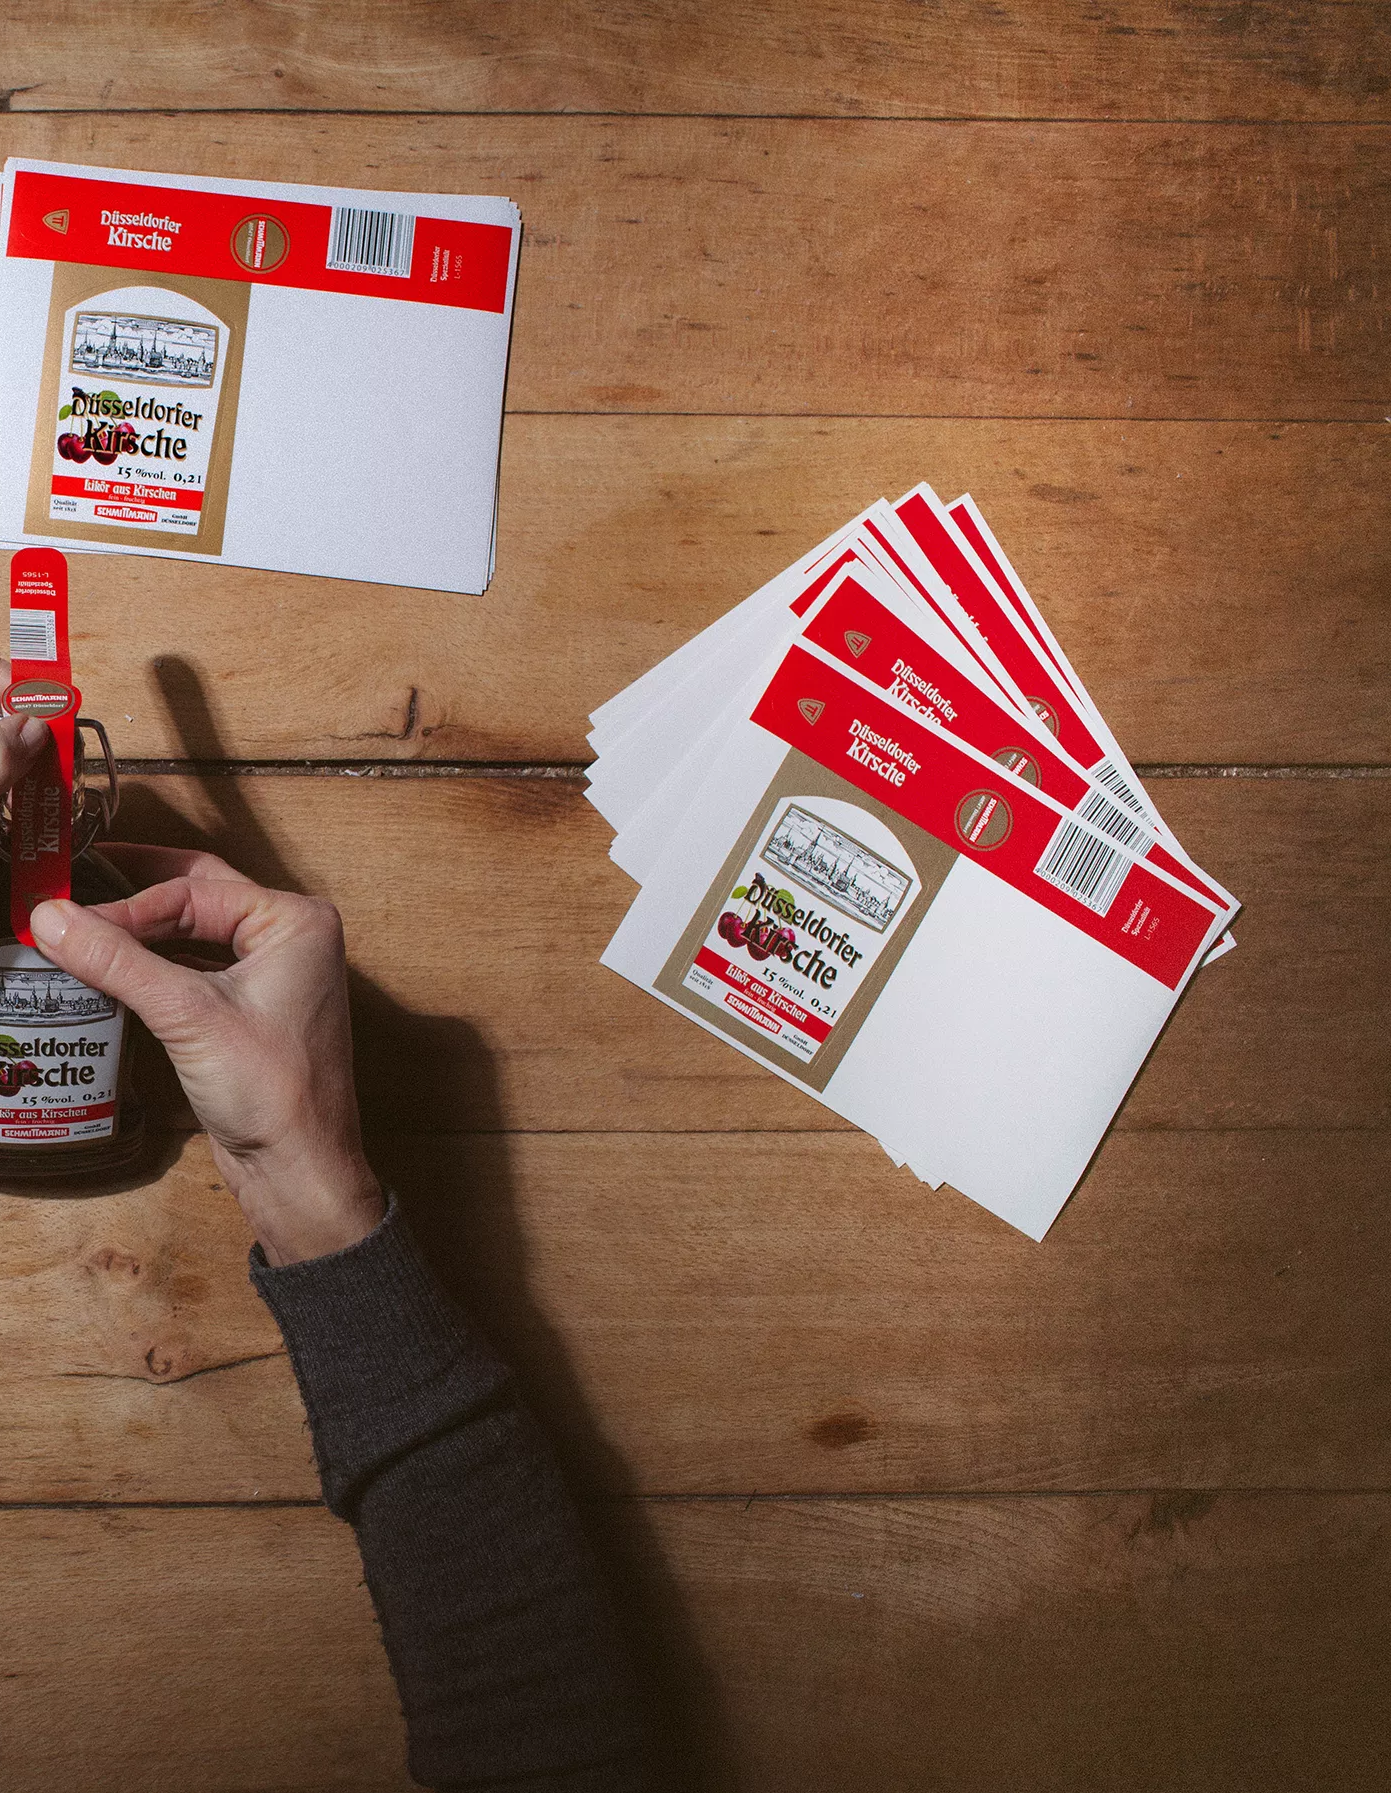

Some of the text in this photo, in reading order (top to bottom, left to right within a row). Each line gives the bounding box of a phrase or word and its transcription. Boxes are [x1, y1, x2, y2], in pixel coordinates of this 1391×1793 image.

[100, 210, 182, 234] Düsseldorfer
[107, 225, 172, 252] Kirsche
[71, 390, 203, 433] Düsseldorfer
[82, 419, 188, 461] Kirsche
[117, 466, 132, 479] 15
[112, 484, 131, 495] aus
[133, 484, 177, 501] Kirschen
[96, 506, 156, 521] SCHMITTMANN
[11, 694, 68, 703] SCHMITTMANN
[890, 658, 958, 723] Düsseldorfer
[848, 719, 921, 775] Düsseldorfer
[845, 738, 907, 788] Kirsche
[744, 881, 863, 969] Düsseldorfer
[741, 909, 838, 990] Kirsche
[762, 966, 778, 982] 15
[726, 994, 780, 1033] SCHMITTMANN
[750, 982, 769, 998] aus
[767, 990, 808, 1023] Kirschen
[19, 1111, 38, 1119] aus
[41, 1108, 88, 1119] Kirschen
[21, 1096, 37, 1107] 15
[4, 1128, 68, 1138] SCHMITTMANN
